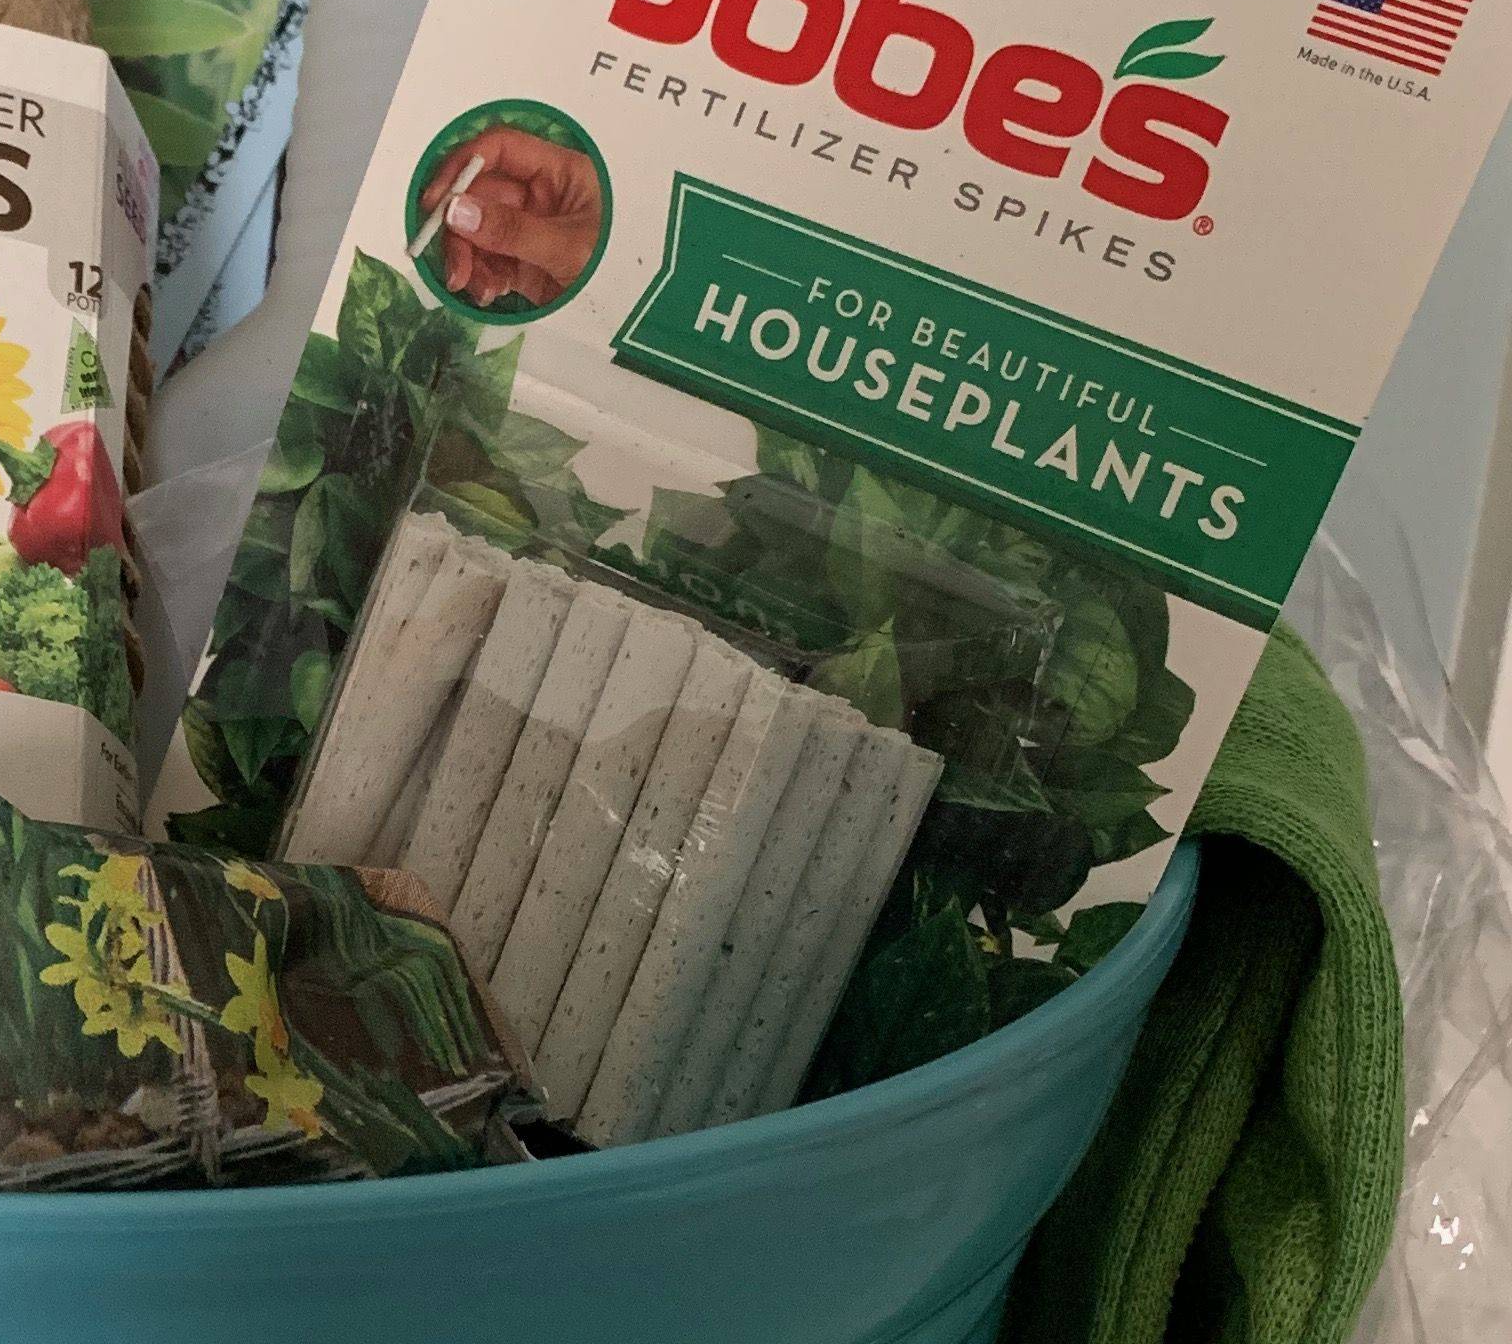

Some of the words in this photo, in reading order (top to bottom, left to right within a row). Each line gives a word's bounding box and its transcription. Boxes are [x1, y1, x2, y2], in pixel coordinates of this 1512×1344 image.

[1297, 46, 1338, 71] Made
[1340, 62, 1356, 77] in
[1359, 67, 1384, 86] the
[589, 51, 920, 191] FERTILIZER
[953, 181, 1177, 283] SPIKES
[68, 261, 103, 302] 12
[807, 276, 894, 332] FOR
[911, 316, 1159, 438] BEAUTIFUL
[693, 283, 1246, 541] HOUSEPLANTS
